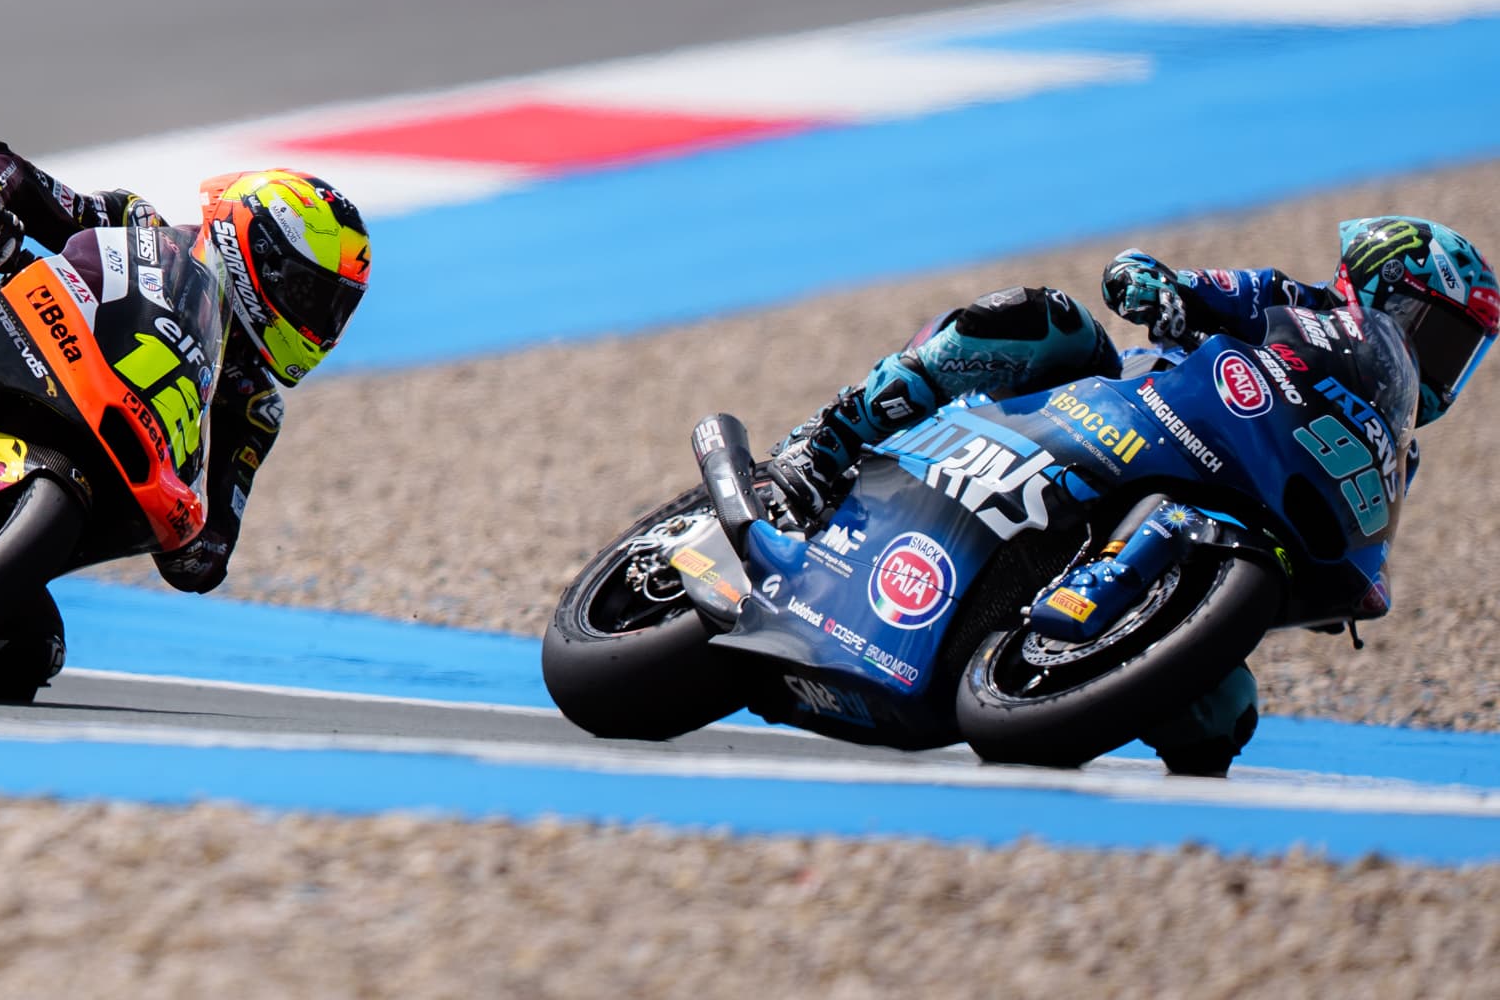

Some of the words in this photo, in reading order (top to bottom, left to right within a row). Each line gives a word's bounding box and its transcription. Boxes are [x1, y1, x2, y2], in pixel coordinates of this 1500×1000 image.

[212, 219, 263, 323] SCORPION
[39, 303, 83, 365] Beta
[154, 316, 206, 367] elf
[114, 332, 201, 470] 12
[1226, 361, 1258, 404] PATA
[138, 406, 166, 464] Beta
[1050, 384, 1147, 465] isocell
[1136, 385, 1224, 474] JUNGHEINRICH
[1292, 414, 1390, 537] 99
[909, 536, 943, 563] SNACK
[884, 555, 933, 605] PATA
[1051, 589, 1090, 617] PIRELLI
[831, 624, 868, 651] COSPE
[866, 643, 894, 665] BRUNO
[892, 659, 919, 682] MOTO
